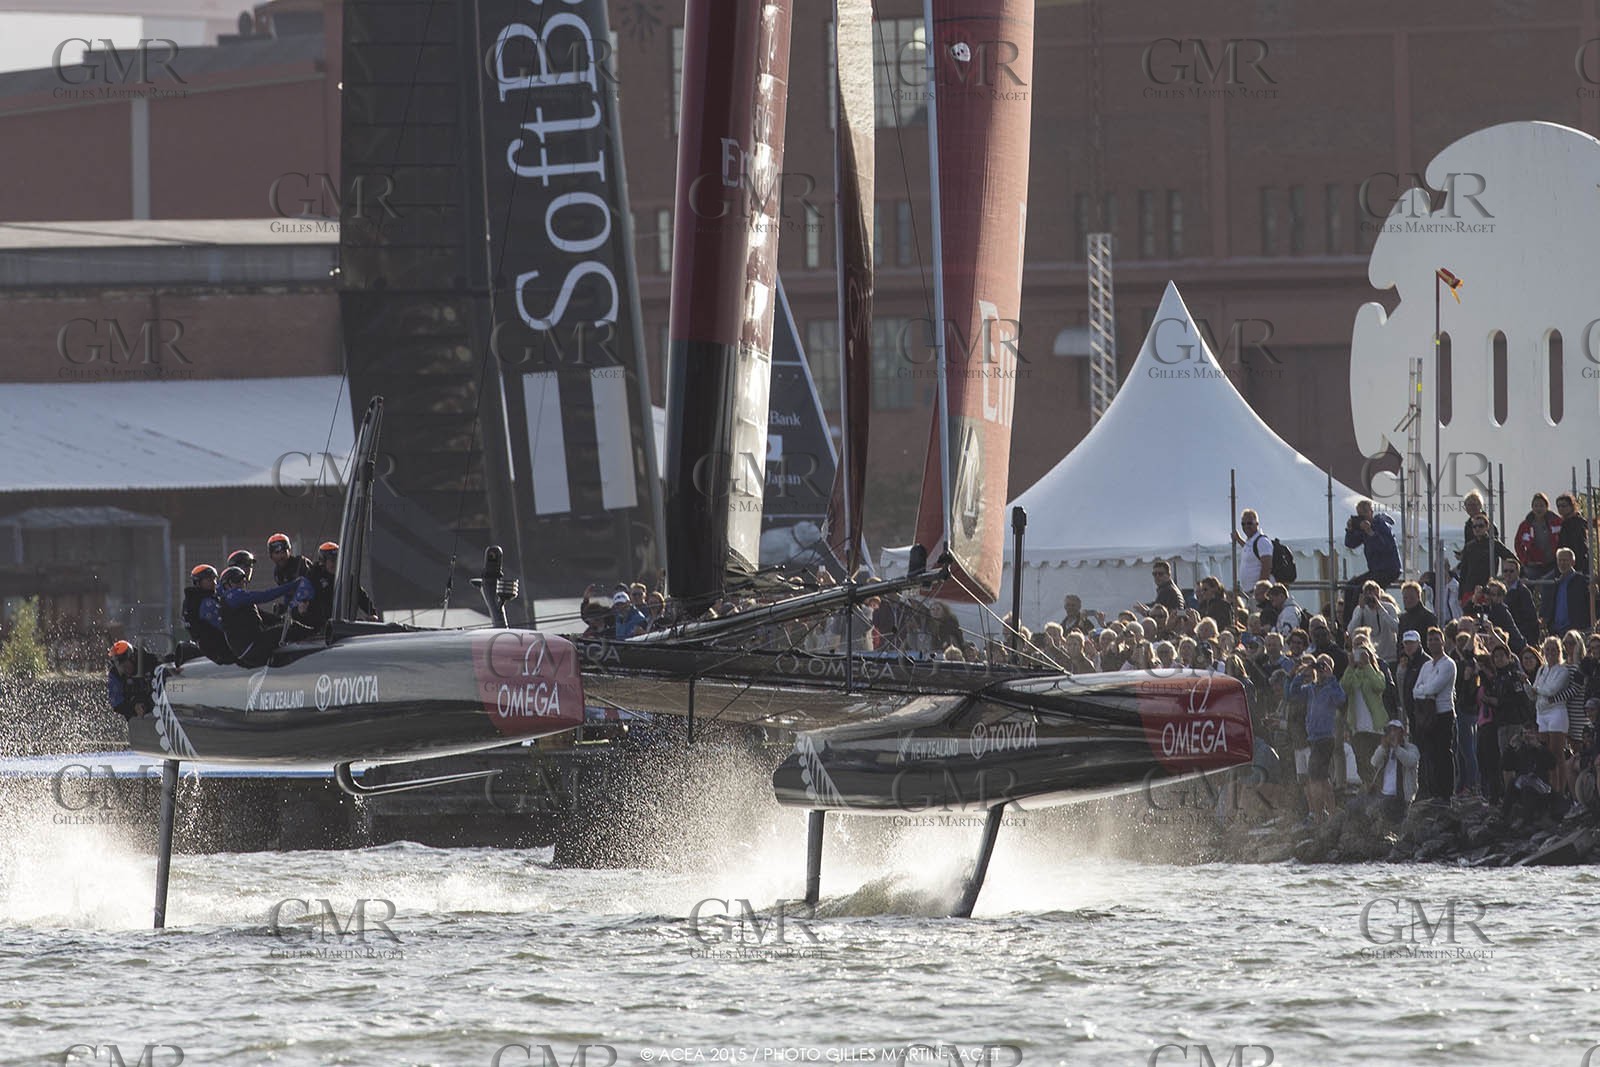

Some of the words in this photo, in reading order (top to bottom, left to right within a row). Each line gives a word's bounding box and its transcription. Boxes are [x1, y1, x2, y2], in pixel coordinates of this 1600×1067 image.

[807, 657, 896, 680] OMEGA
[259, 692, 275, 710] NEW
[275, 689, 305, 710] ZEALAND
[333, 675, 379, 706] TOYOTA
[497, 682, 560, 718] OMEGA
[910, 743, 927, 760] NEW
[928, 738, 959, 759] ZEALAND
[990, 722, 1037, 753] TOYOTA
[1162, 720, 1227, 756] OMEGA
